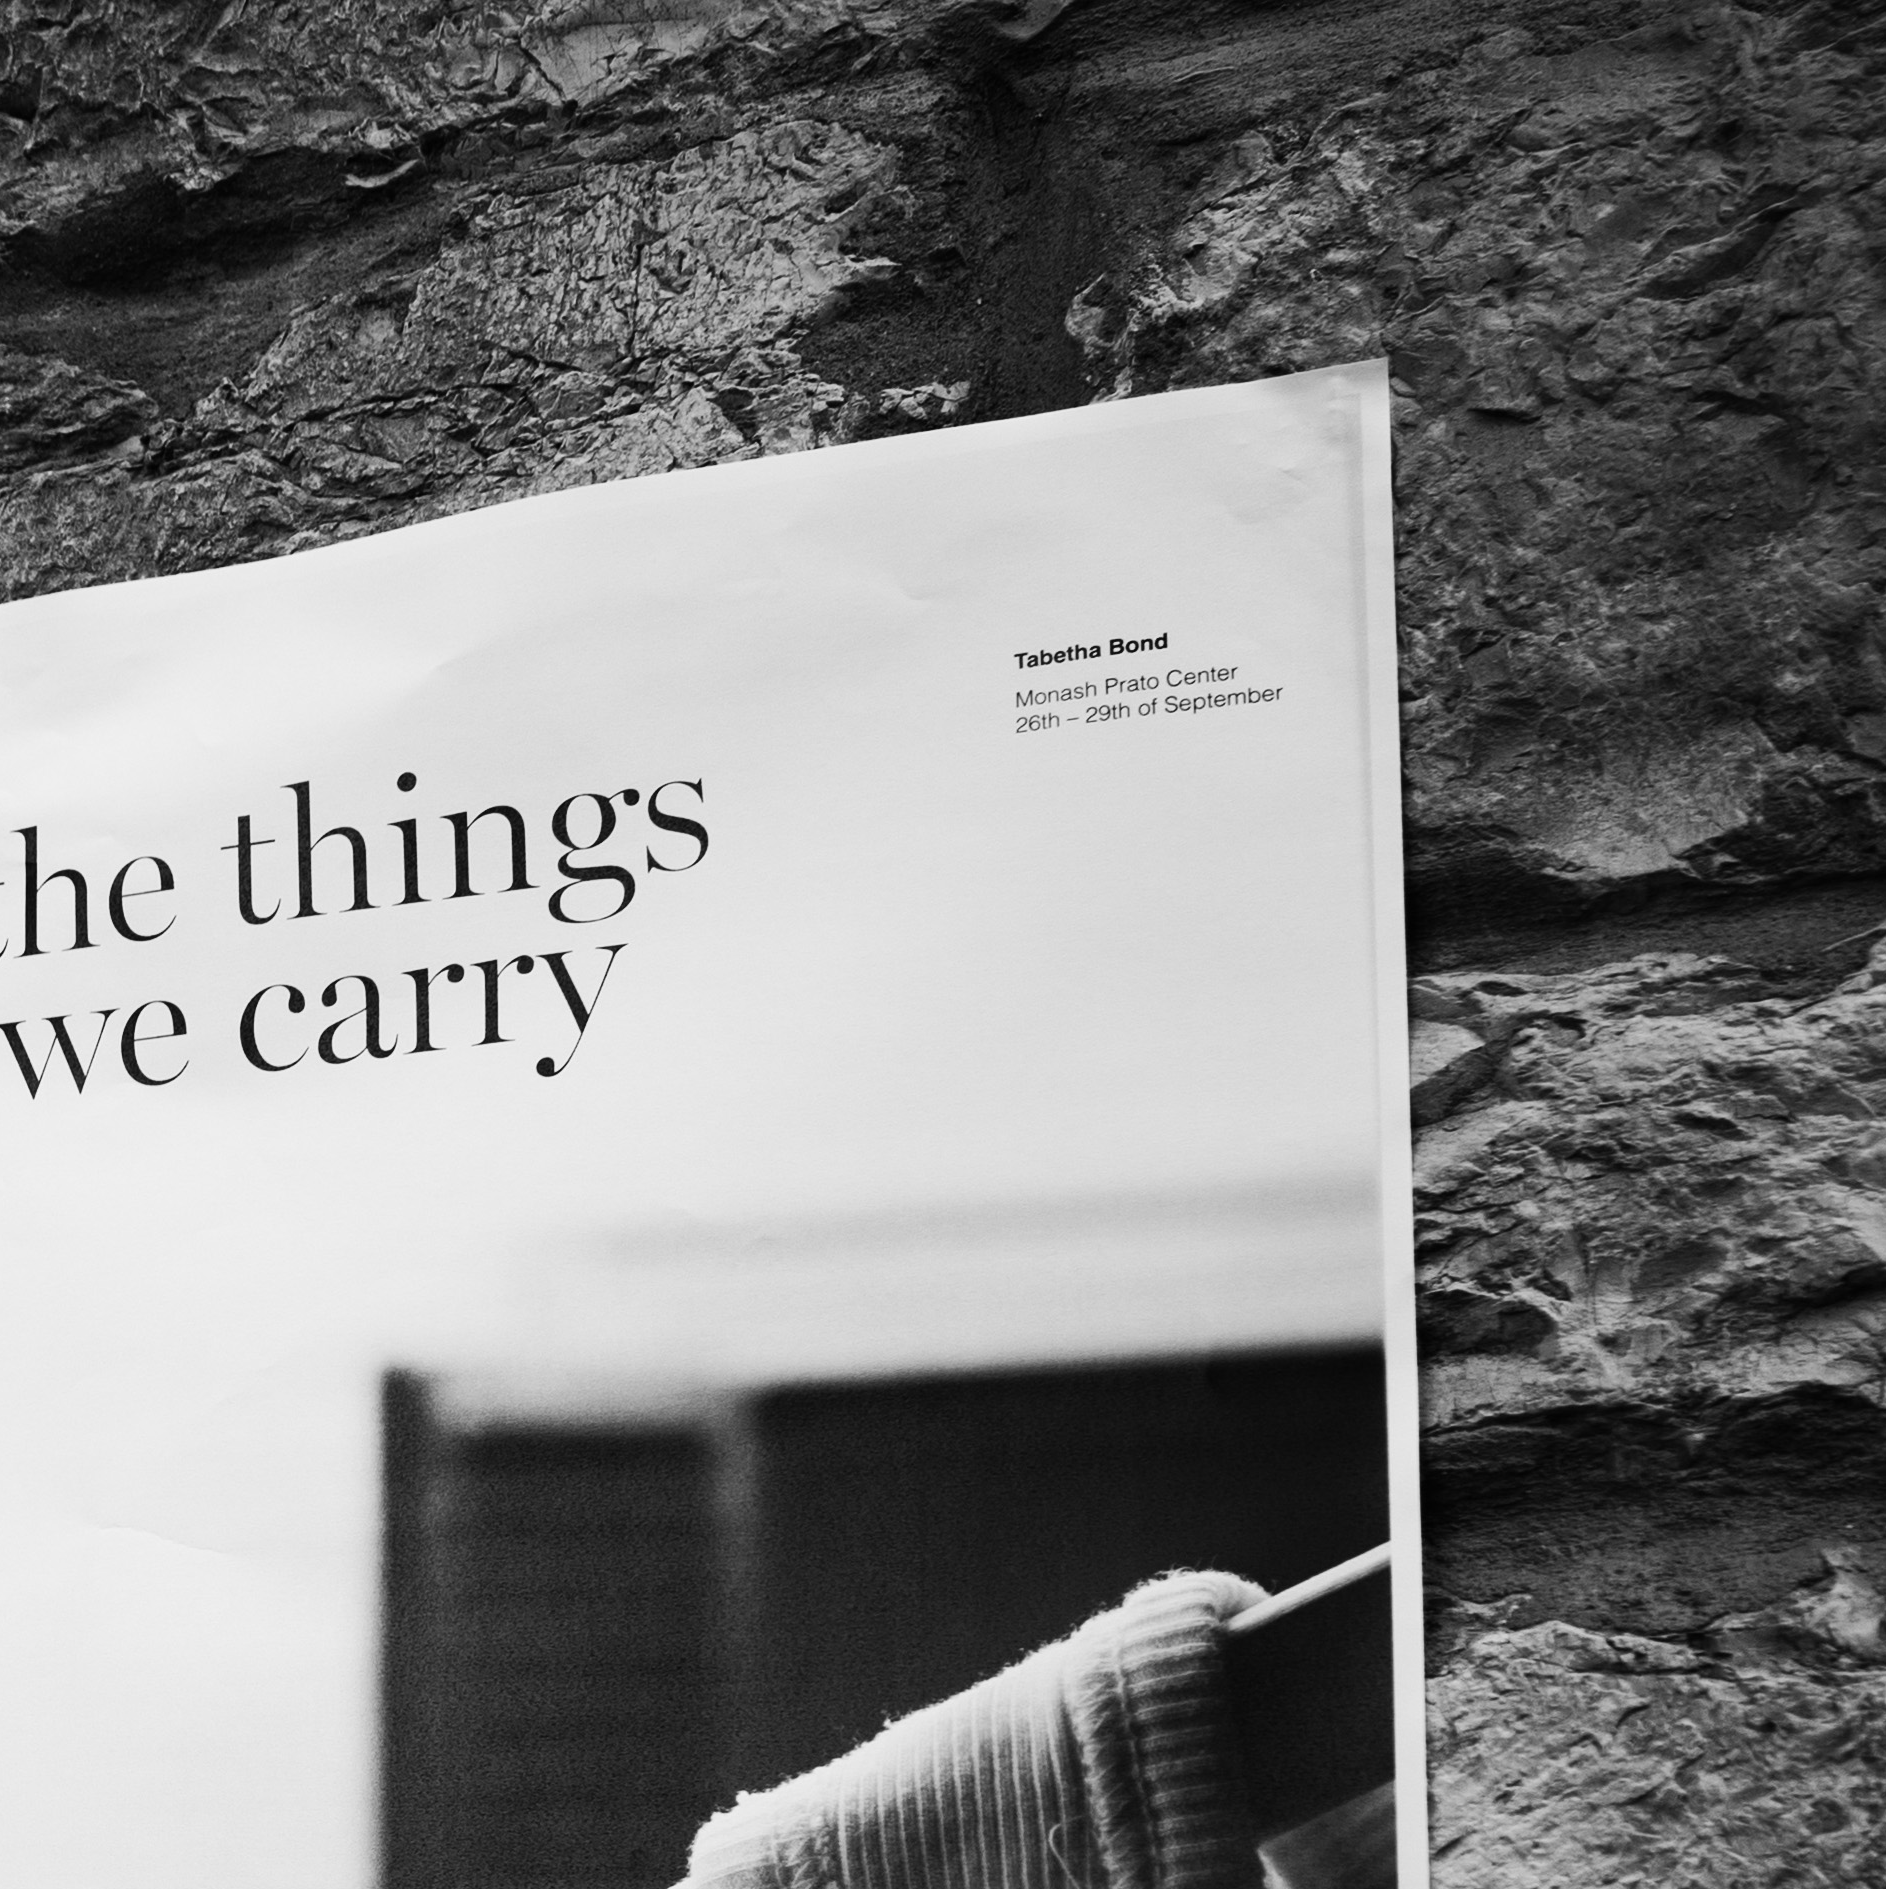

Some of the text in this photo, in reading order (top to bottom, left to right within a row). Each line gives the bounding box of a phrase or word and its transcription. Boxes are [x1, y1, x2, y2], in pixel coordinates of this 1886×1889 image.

[1013, 631, 1169, 670] Tabetha Bond
[1015, 666, 1239, 708] Monash Prato Center
[1015, 712, 1060, 734] 26th
[1085, 702, 1131, 724] 29th
[1137, 697, 1158, 717] of
[1164, 685, 1284, 715] September
[220, 771, 710, 926] things
[239, 943, 629, 1078] carry
